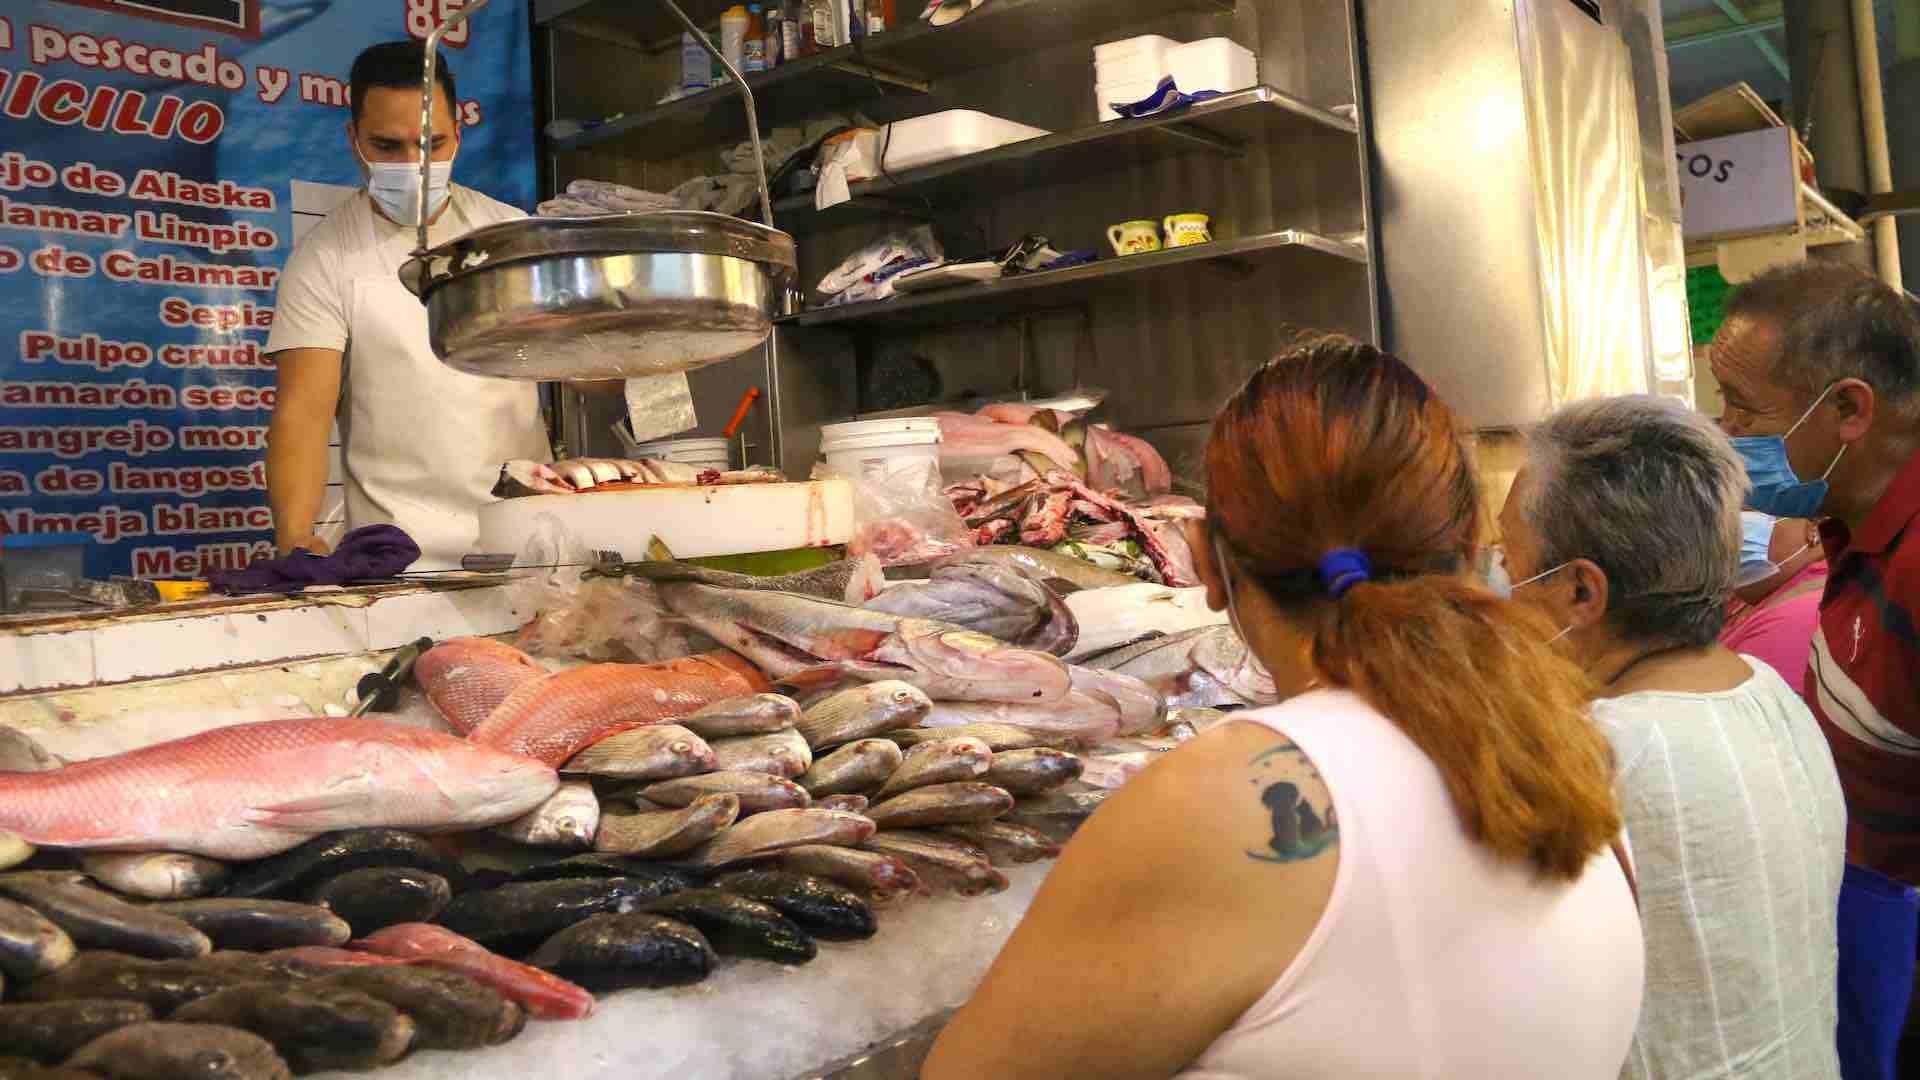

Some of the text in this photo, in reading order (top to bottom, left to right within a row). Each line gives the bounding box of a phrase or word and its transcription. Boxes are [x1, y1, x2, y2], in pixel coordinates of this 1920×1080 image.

[29, 24, 247, 90] pescado
[256, 66, 290, 104] y
[0, 153, 275, 211] jo de Alaska
[1676, 152, 1734, 184] OS
[136, 212, 277, 253] Limpio
[33, 247, 94, 276] de
[104, 250, 279, 289] Calamar
[162, 298, 274, 332] Sepia
[22, 332, 151, 370] Pulpo
[2, 380, 175, 408] amarón
[0, 421, 272, 457] angrejo mor
[37, 464, 102, 494] de
